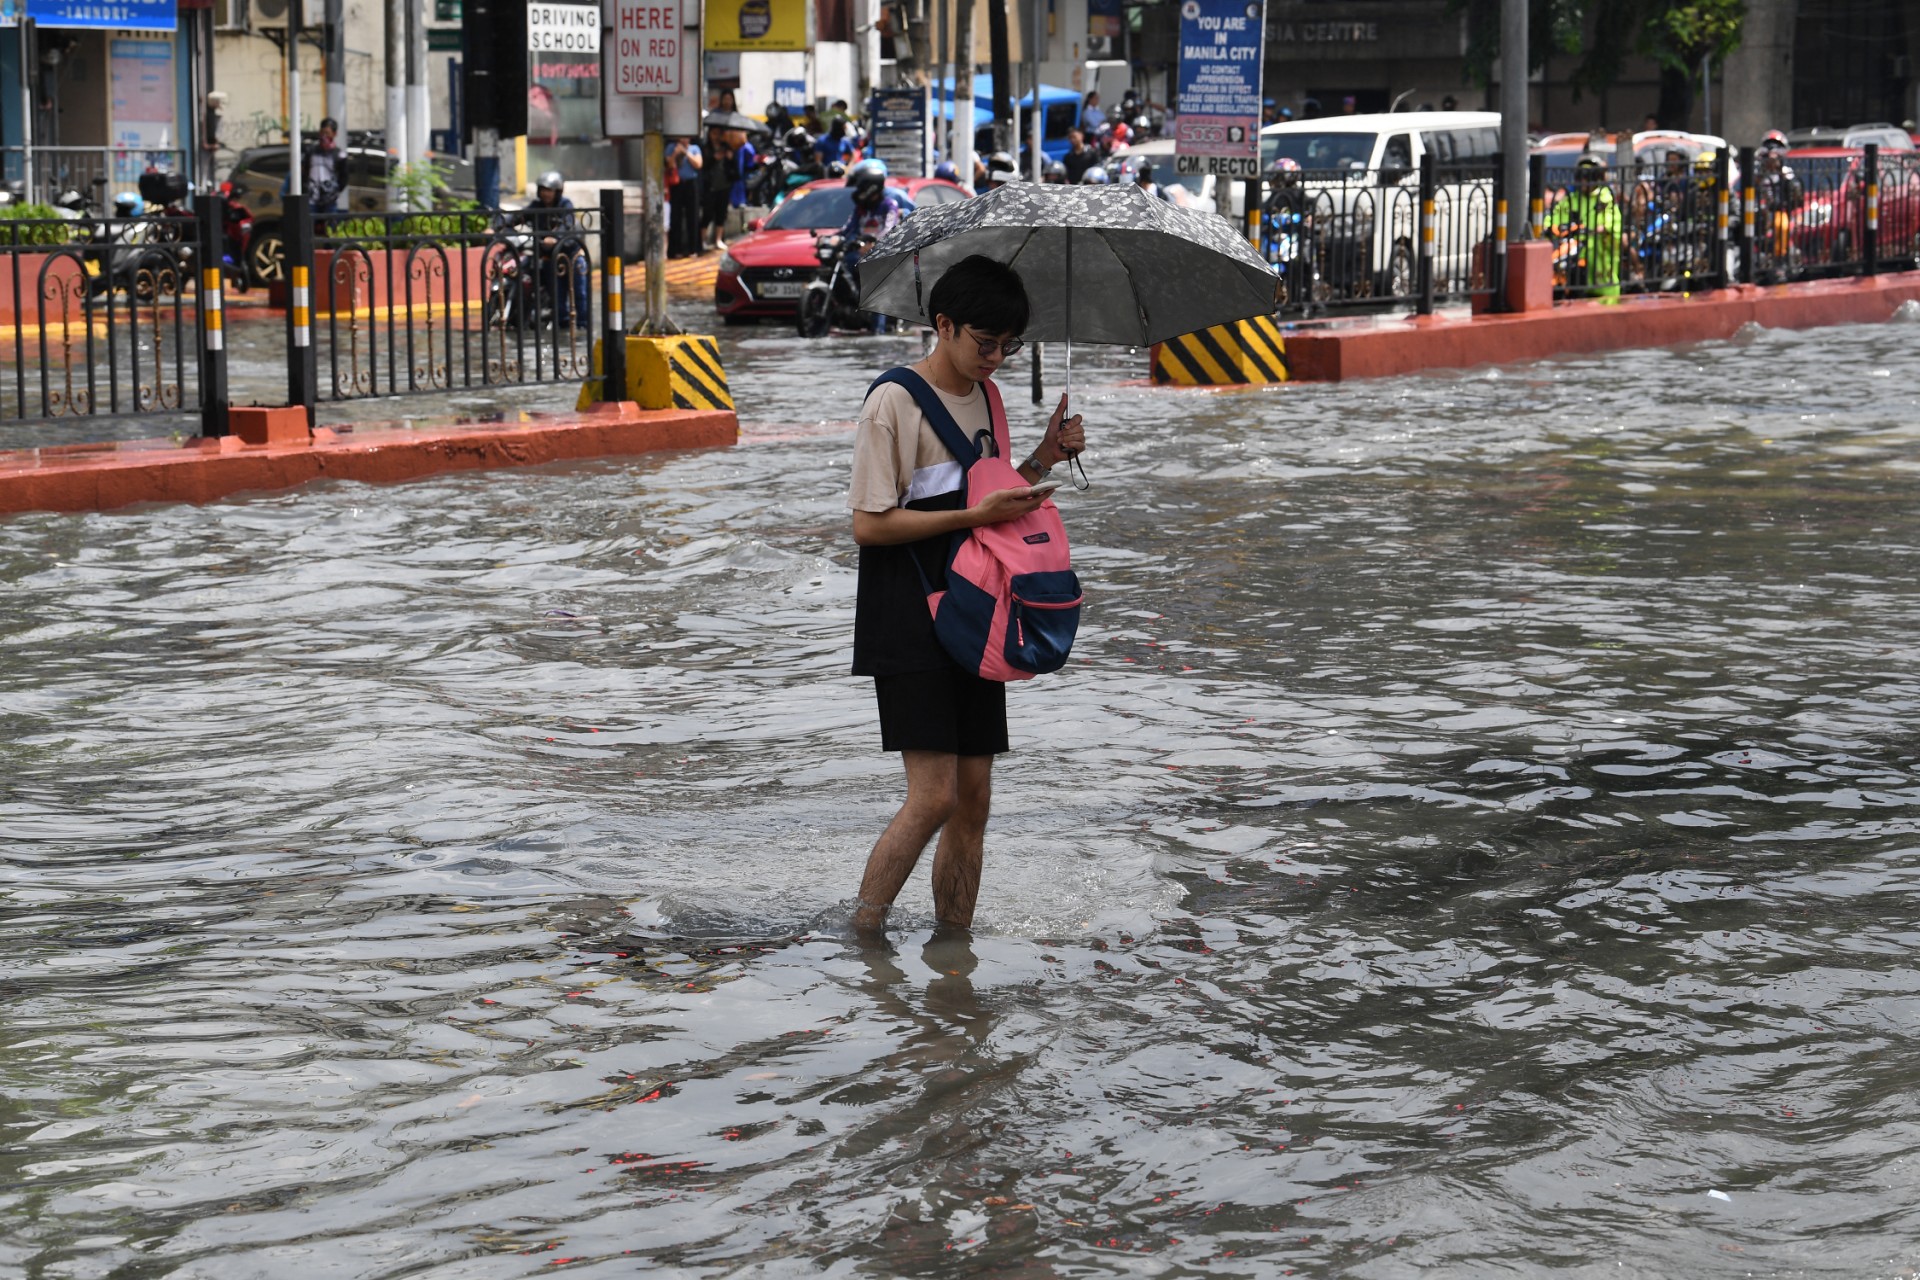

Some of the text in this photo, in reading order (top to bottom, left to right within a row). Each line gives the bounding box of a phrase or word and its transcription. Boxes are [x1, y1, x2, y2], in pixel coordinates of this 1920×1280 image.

[531, 9, 596, 27] DRIVING
[621, 8, 675, 30] HERE
[1198, 16, 1247, 31] YOU ARE
[1214, 31, 1228, 46] IN
[1302, 22, 1378, 41] CENTRE
[532, 32, 595, 50] SCHOOL
[621, 39, 676, 57] ON RED
[1184, 45, 1257, 61] MANILA CITY
[622, 65, 673, 84] SIGNAL
[1200, 65, 1241, 75] NO CONTACT
[1179, 93, 1203, 103] PLEASE
[1188, 84, 1252, 94] PROGRAM IN EFFECT
[1179, 103, 1200, 113] RULES
[1200, 104, 1215, 113] AND
[1181, 123, 1225, 142] SOGO
[1177, 156, 1258, 175] CM. RECTO
